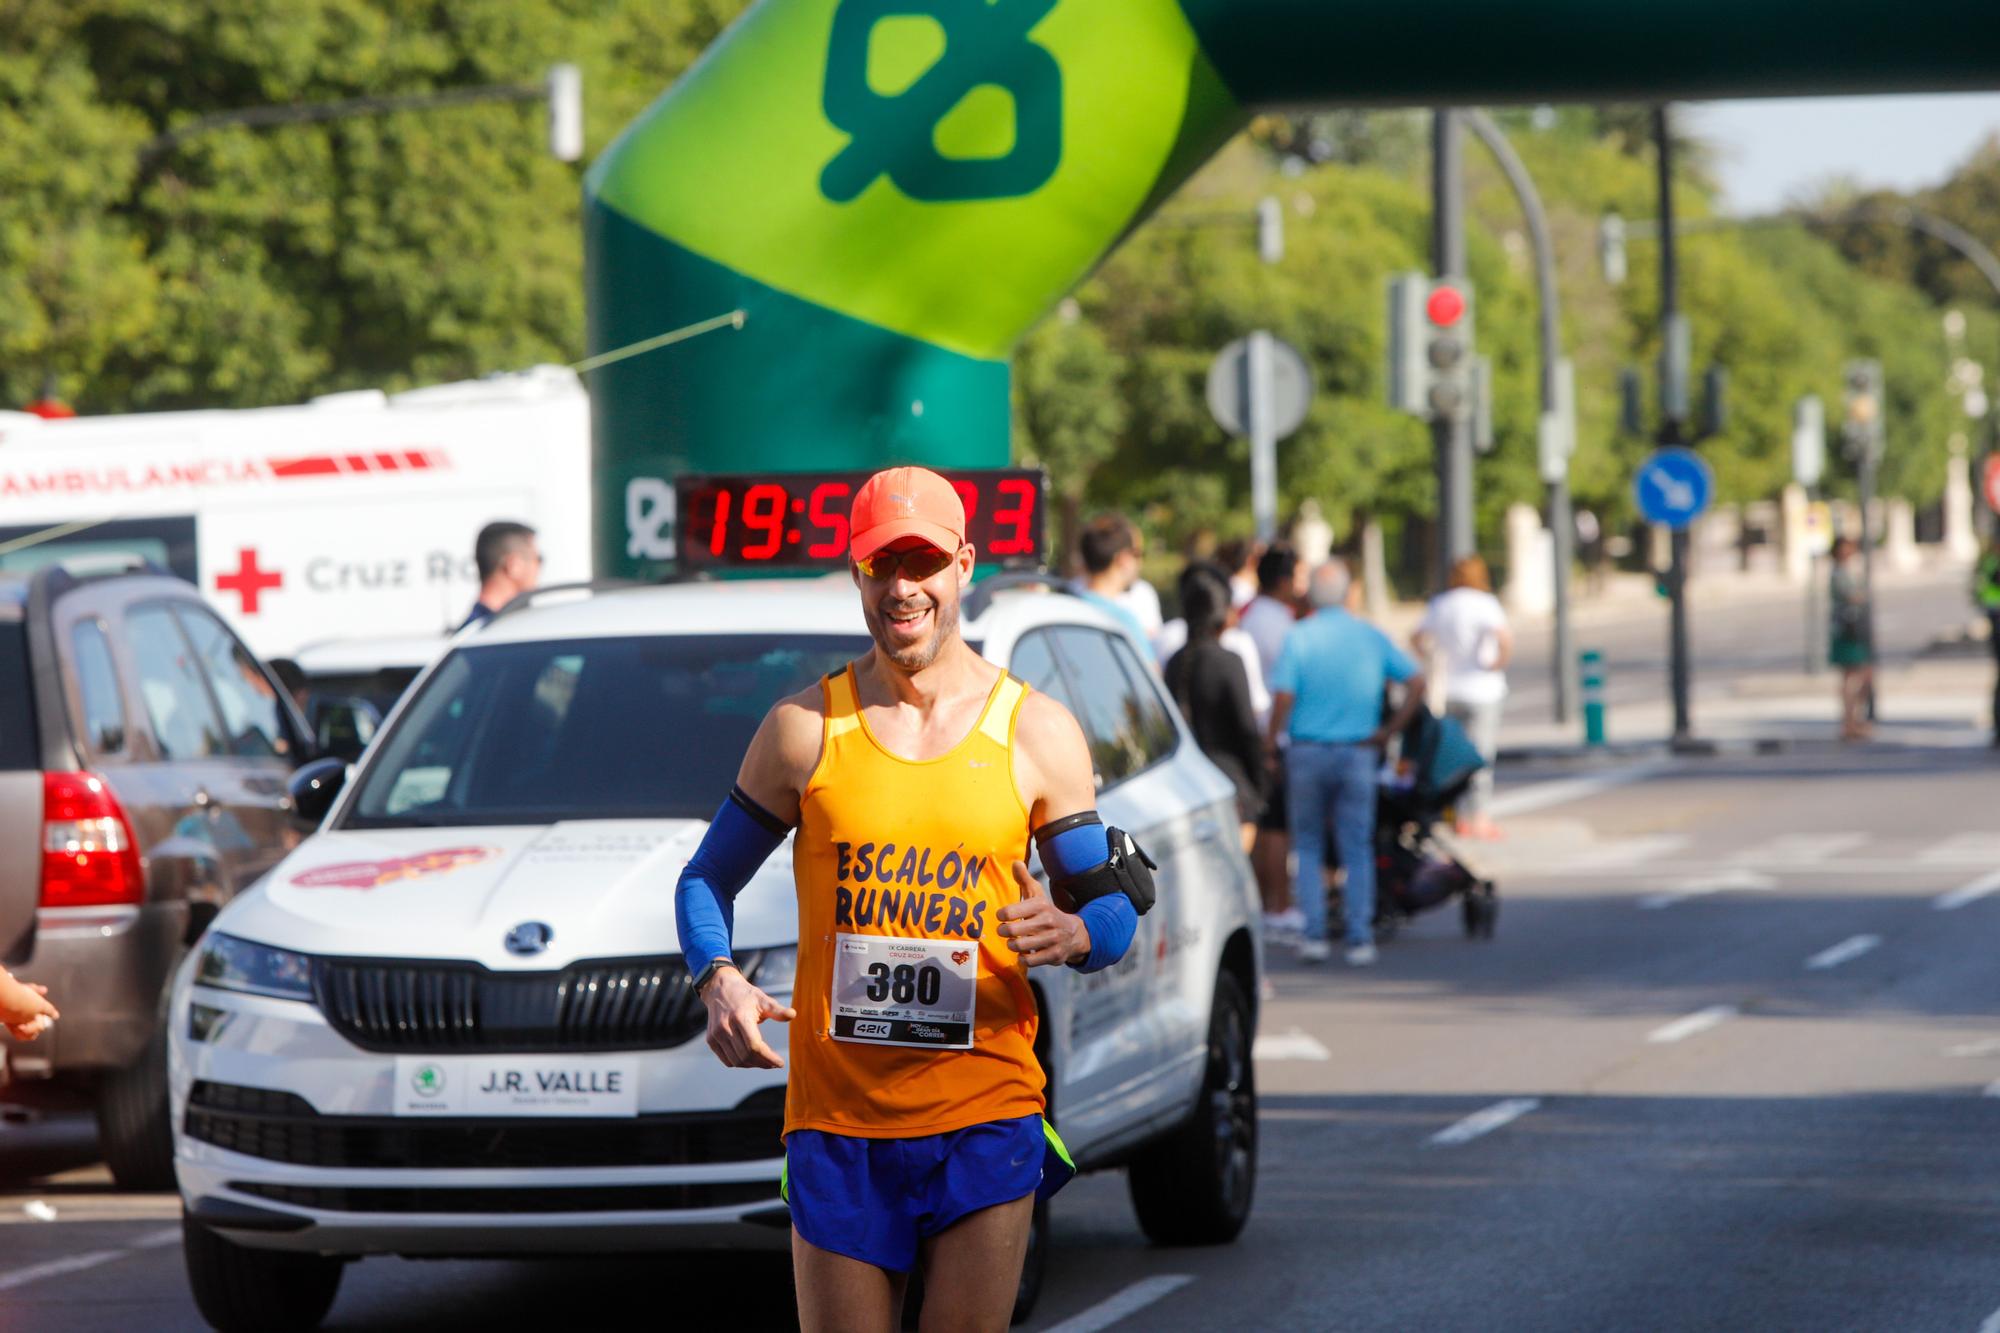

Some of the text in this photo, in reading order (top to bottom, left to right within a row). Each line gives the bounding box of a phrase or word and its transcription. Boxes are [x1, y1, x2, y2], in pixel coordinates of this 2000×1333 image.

[2, 459, 262, 497] AMBULANCIA
[305, 551, 477, 593] Cruz Ro
[836, 842, 987, 891] ESCALÓN
[836, 886, 987, 939] RUNNERS
[866, 962, 941, 1006] 380
[857, 1024, 889, 1035] 42K
[480, 1070, 622, 1093] J.R. VALLE
